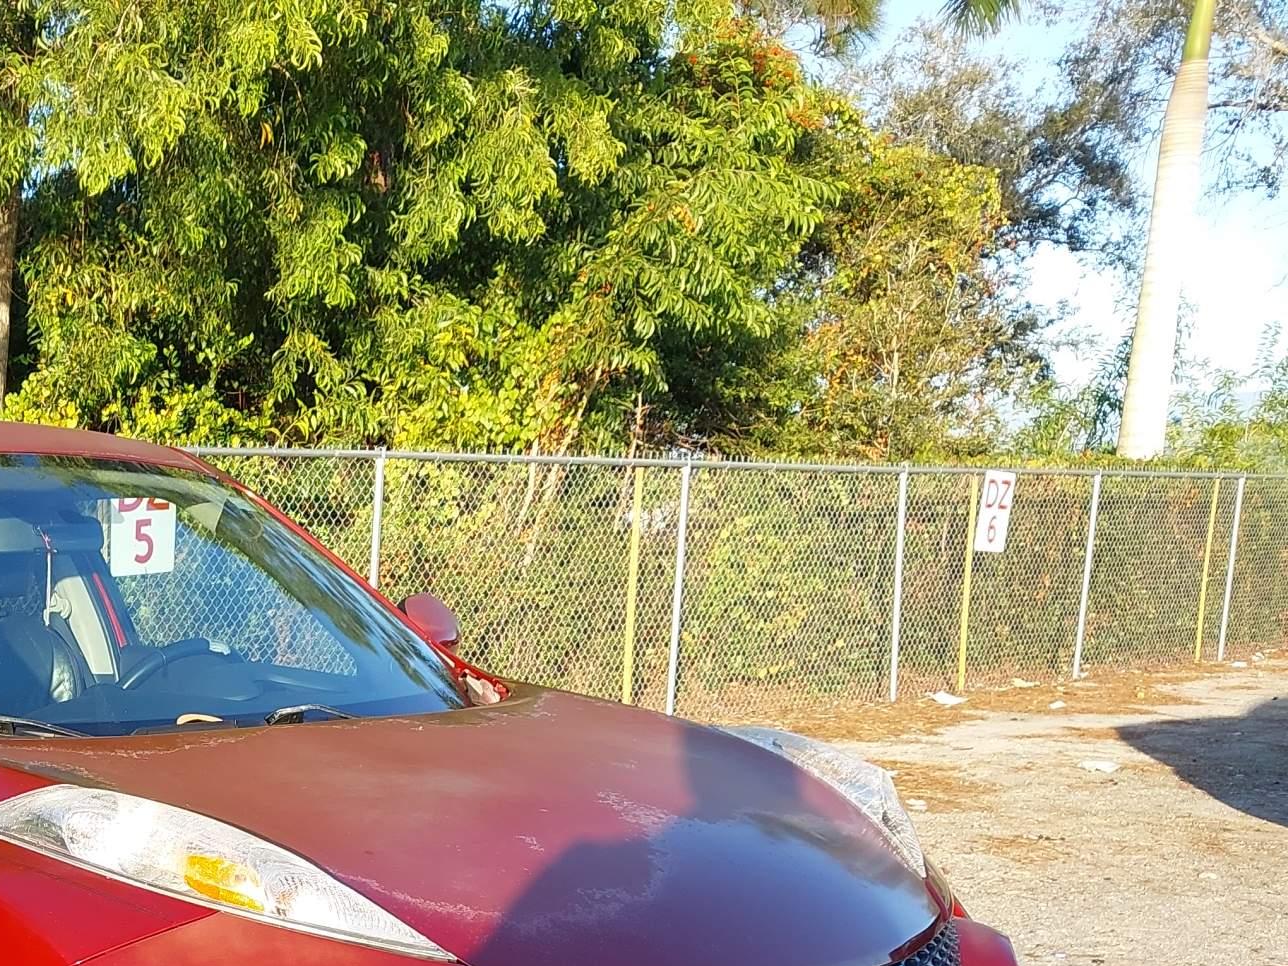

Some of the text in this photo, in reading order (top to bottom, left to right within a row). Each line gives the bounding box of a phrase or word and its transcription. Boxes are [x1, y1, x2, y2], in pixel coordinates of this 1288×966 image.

[985, 479, 1012, 510] DZ
[134, 518, 154, 564] 5
[987, 515, 997, 544] 6
